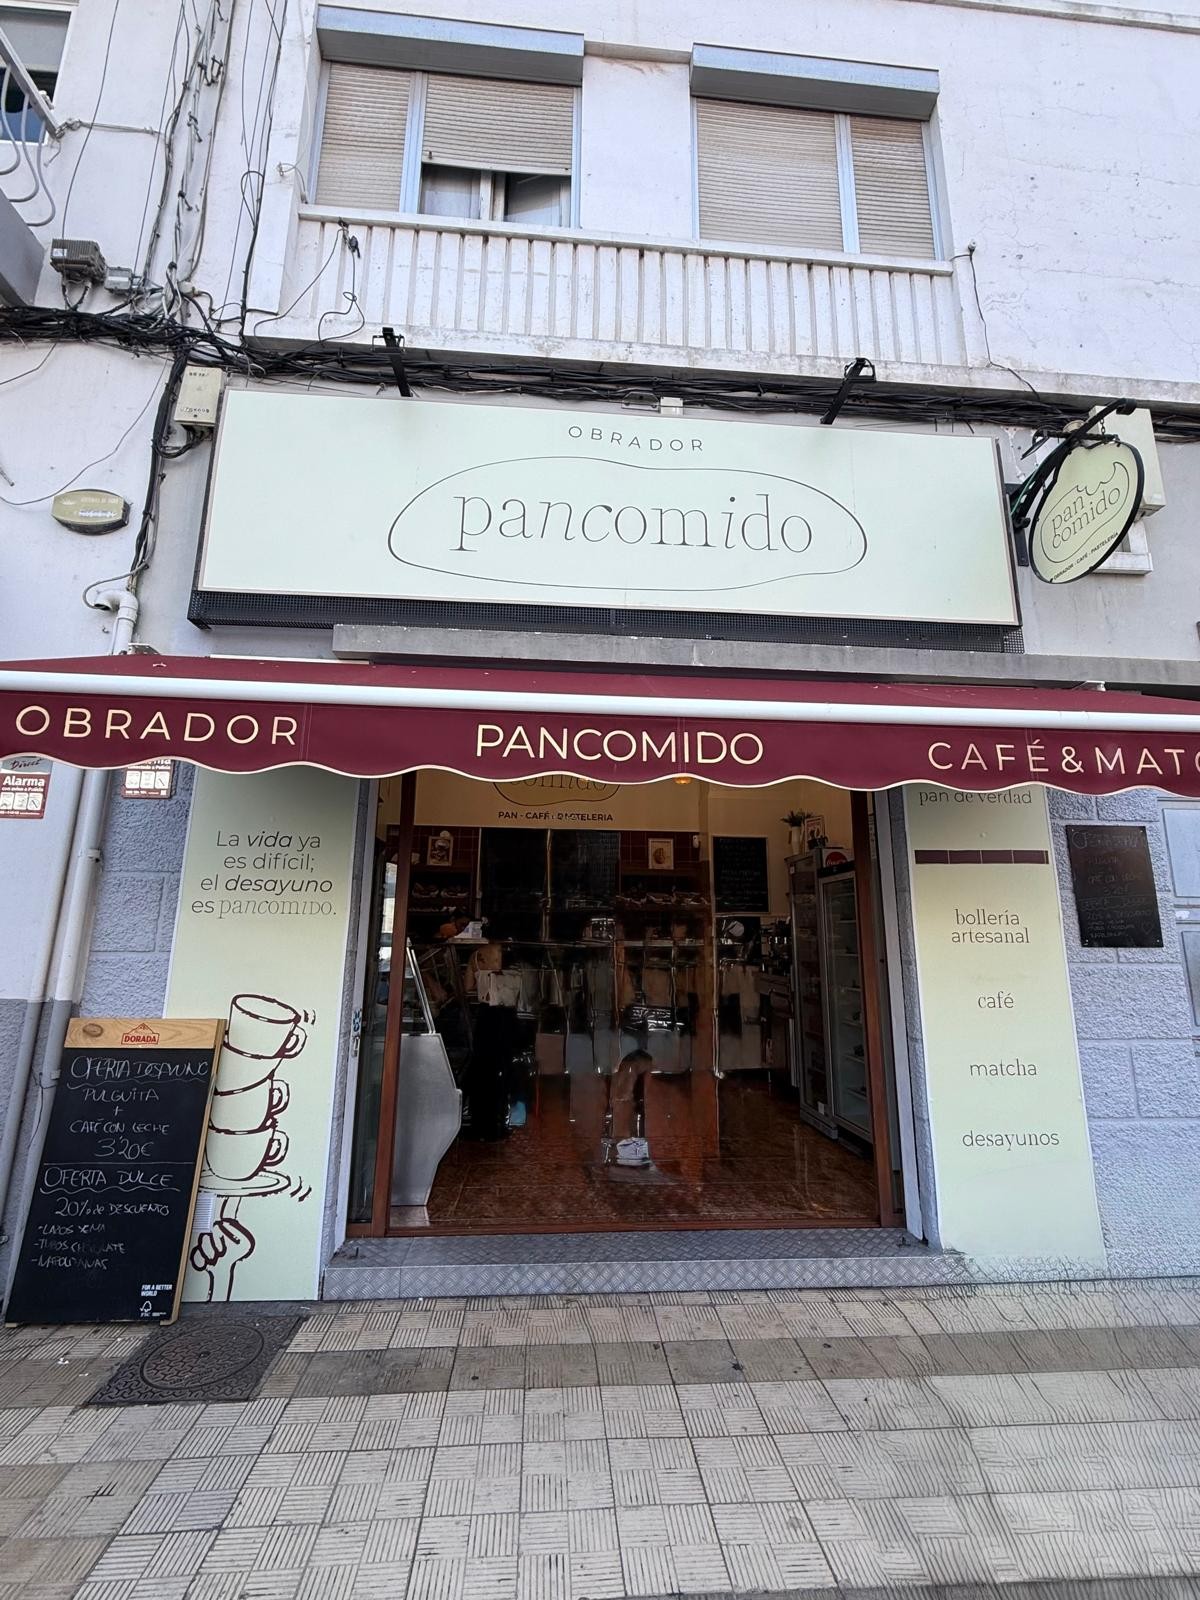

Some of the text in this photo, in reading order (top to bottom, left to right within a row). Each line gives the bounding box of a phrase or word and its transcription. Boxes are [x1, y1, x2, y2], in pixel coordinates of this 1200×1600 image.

[568, 425, 704, 452] OBRADOR
[449, 493, 813, 554] pancomido
[1051, 495, 1085, 535] pan
[1051, 487, 1121, 549] comido
[15, 705, 298, 746] OBRADOR
[475, 723, 764, 765] PANCOMIDO
[3, 775, 46, 787] Alarma
[919, 789, 1033, 806] pan de verdad
[498, 811, 518, 819] PAN
[216, 830, 321, 852] La vida ya
[224, 852, 315, 873] es difícil;
[200, 874, 333, 896] el desayuno
[191, 900, 215, 914] es
[955, 908, 1020, 926] bollería
[951, 927, 1030, 944] artesanal
[977, 991, 1014, 1009] café
[124, 1035, 156, 1043] DORADA
[70, 1056, 131, 1080] OFERTA
[970, 1058, 1037, 1077] matcha
[103, 1120, 125, 1134] CON
[132, 1122, 171, 1135] LECHE
[962, 1130, 1060, 1151] desayunos
[44, 1166, 174, 1188] OFERTA DULCE
